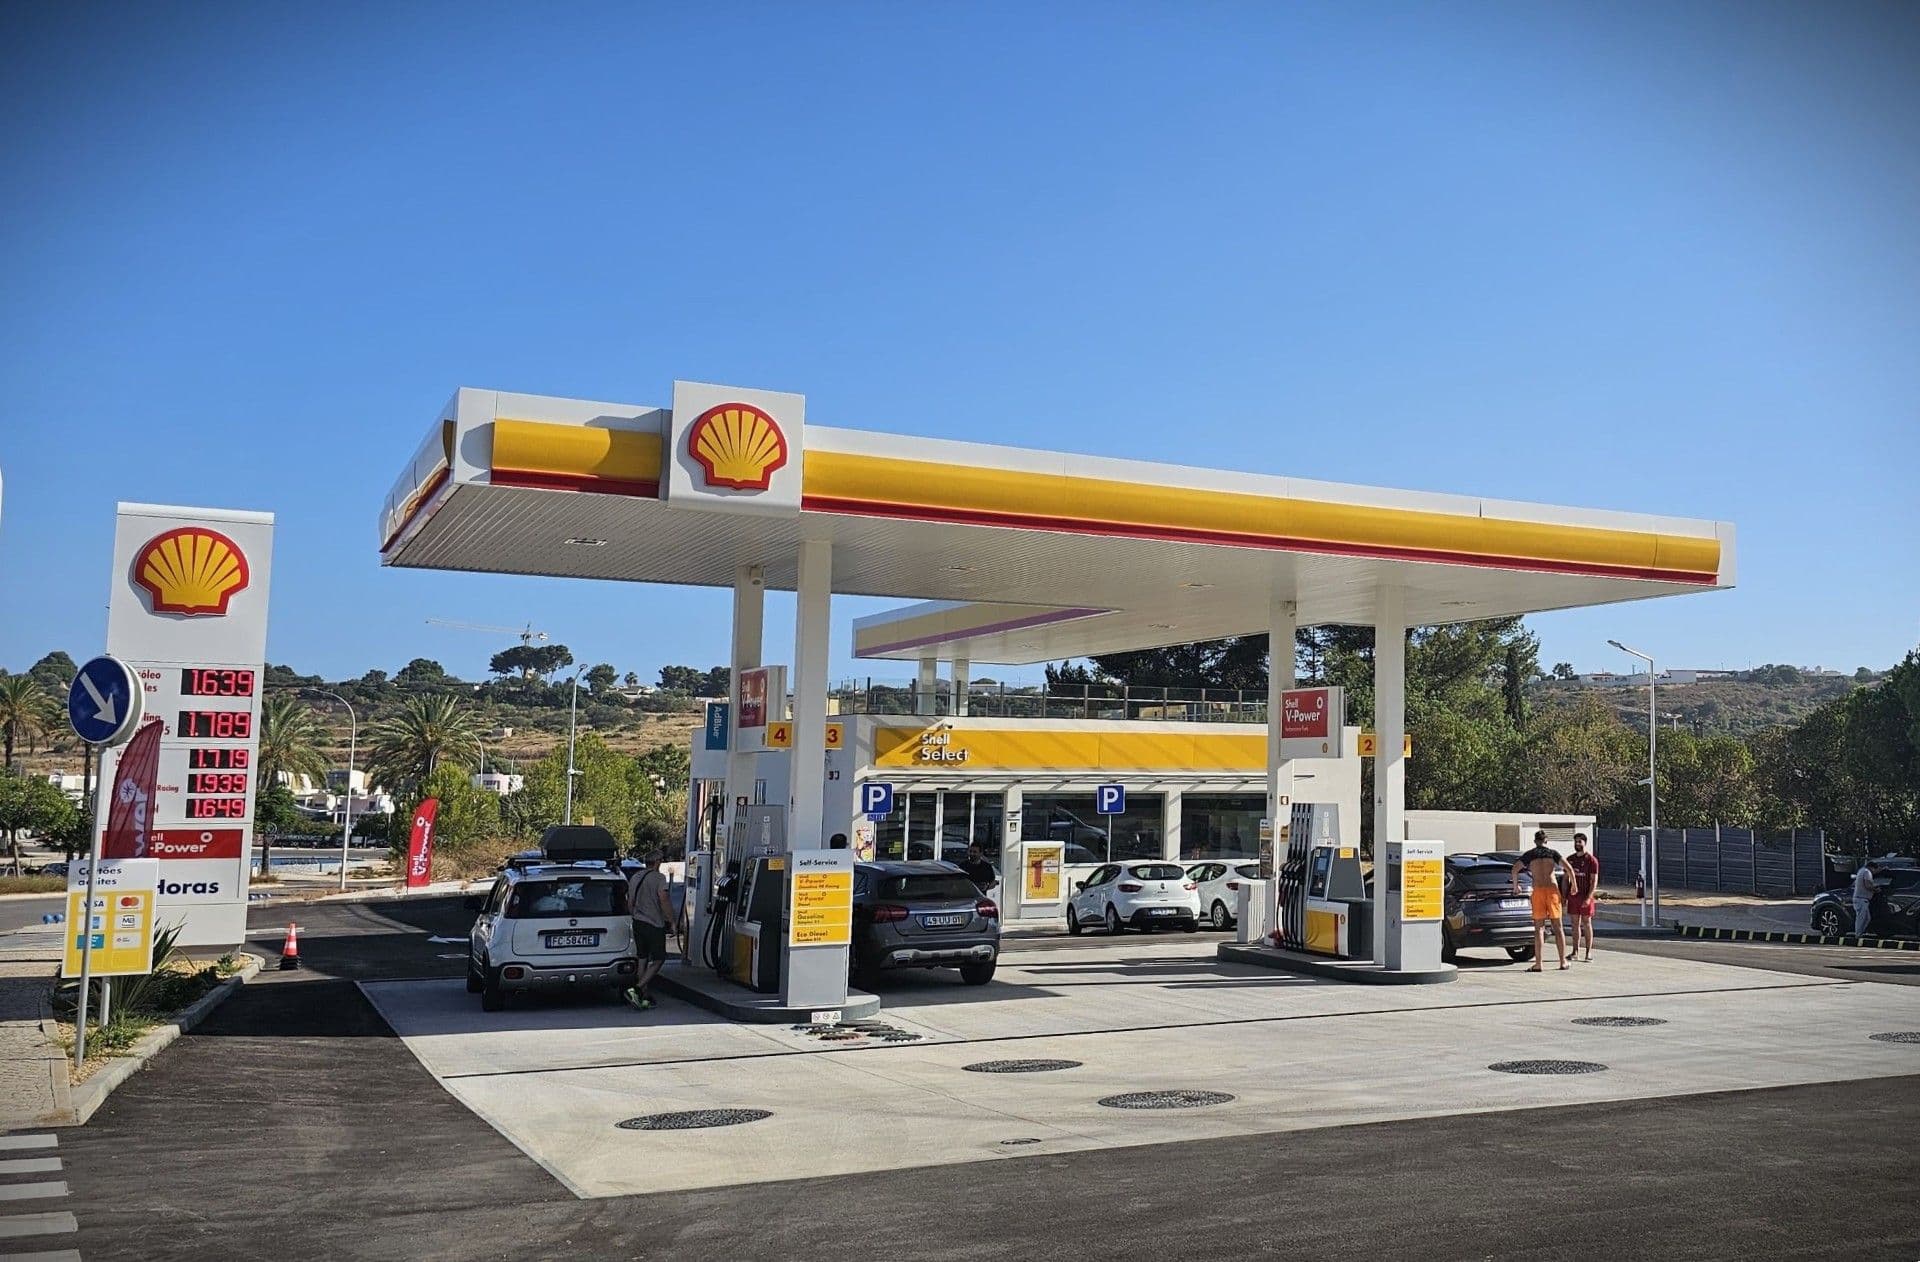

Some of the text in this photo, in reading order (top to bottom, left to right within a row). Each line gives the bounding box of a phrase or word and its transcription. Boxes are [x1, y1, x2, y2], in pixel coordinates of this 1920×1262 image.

[191, 669, 253, 695] 1.639
[1285, 698, 1299, 709] Shell
[188, 712, 250, 737] 1.789
[713, 706, 722, 737] AdBlue
[1285, 709, 1320, 723] V-Power
[774, 727, 787, 742] 4
[827, 728, 838, 743] 3
[922, 733, 951, 745] Shell
[921, 746, 968, 760] Select
[1364, 739, 1373, 752] 2
[198, 749, 248, 768] 1.719
[196, 774, 246, 792] 1.939
[868, 786, 886, 811] P
[1103, 787, 1118, 811] P
[194, 799, 244, 817] 1.649
[418, 821, 431, 875] V-Power
